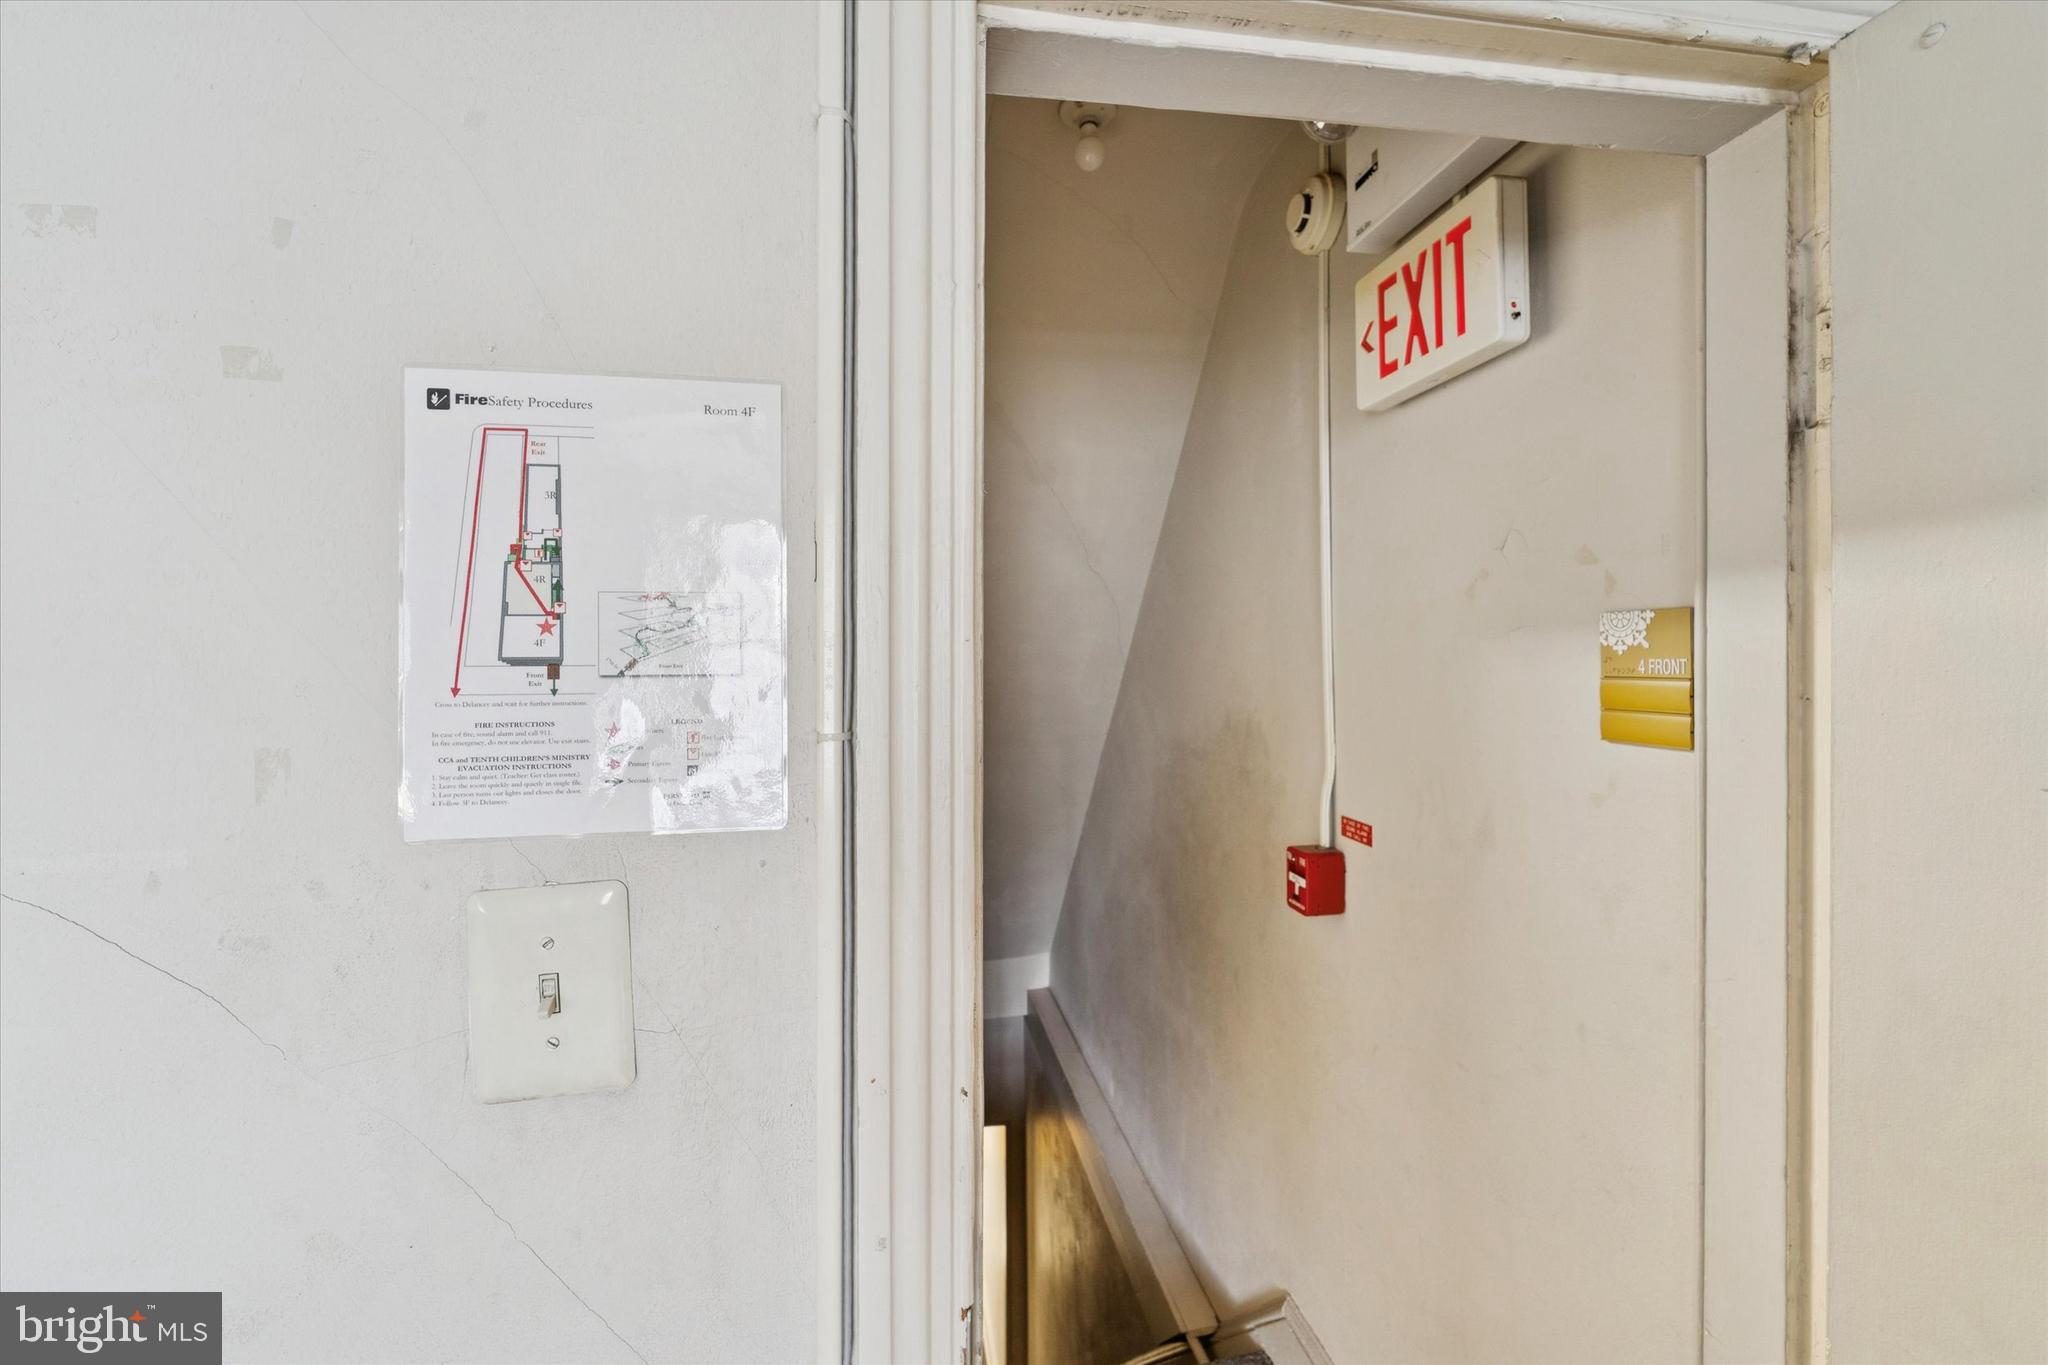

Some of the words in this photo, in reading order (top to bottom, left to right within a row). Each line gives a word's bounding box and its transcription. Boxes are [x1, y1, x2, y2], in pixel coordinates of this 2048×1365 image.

[1378, 215, 1472, 379] EXIT
[455, 393, 524, 410] FireSafety
[528, 397, 593, 410] Procedures
[704, 404, 738, 416] Room
[741, 406, 756, 416] 4F
[1638, 658, 1645, 674] 4
[1648, 658, 1688, 675] FRONT
